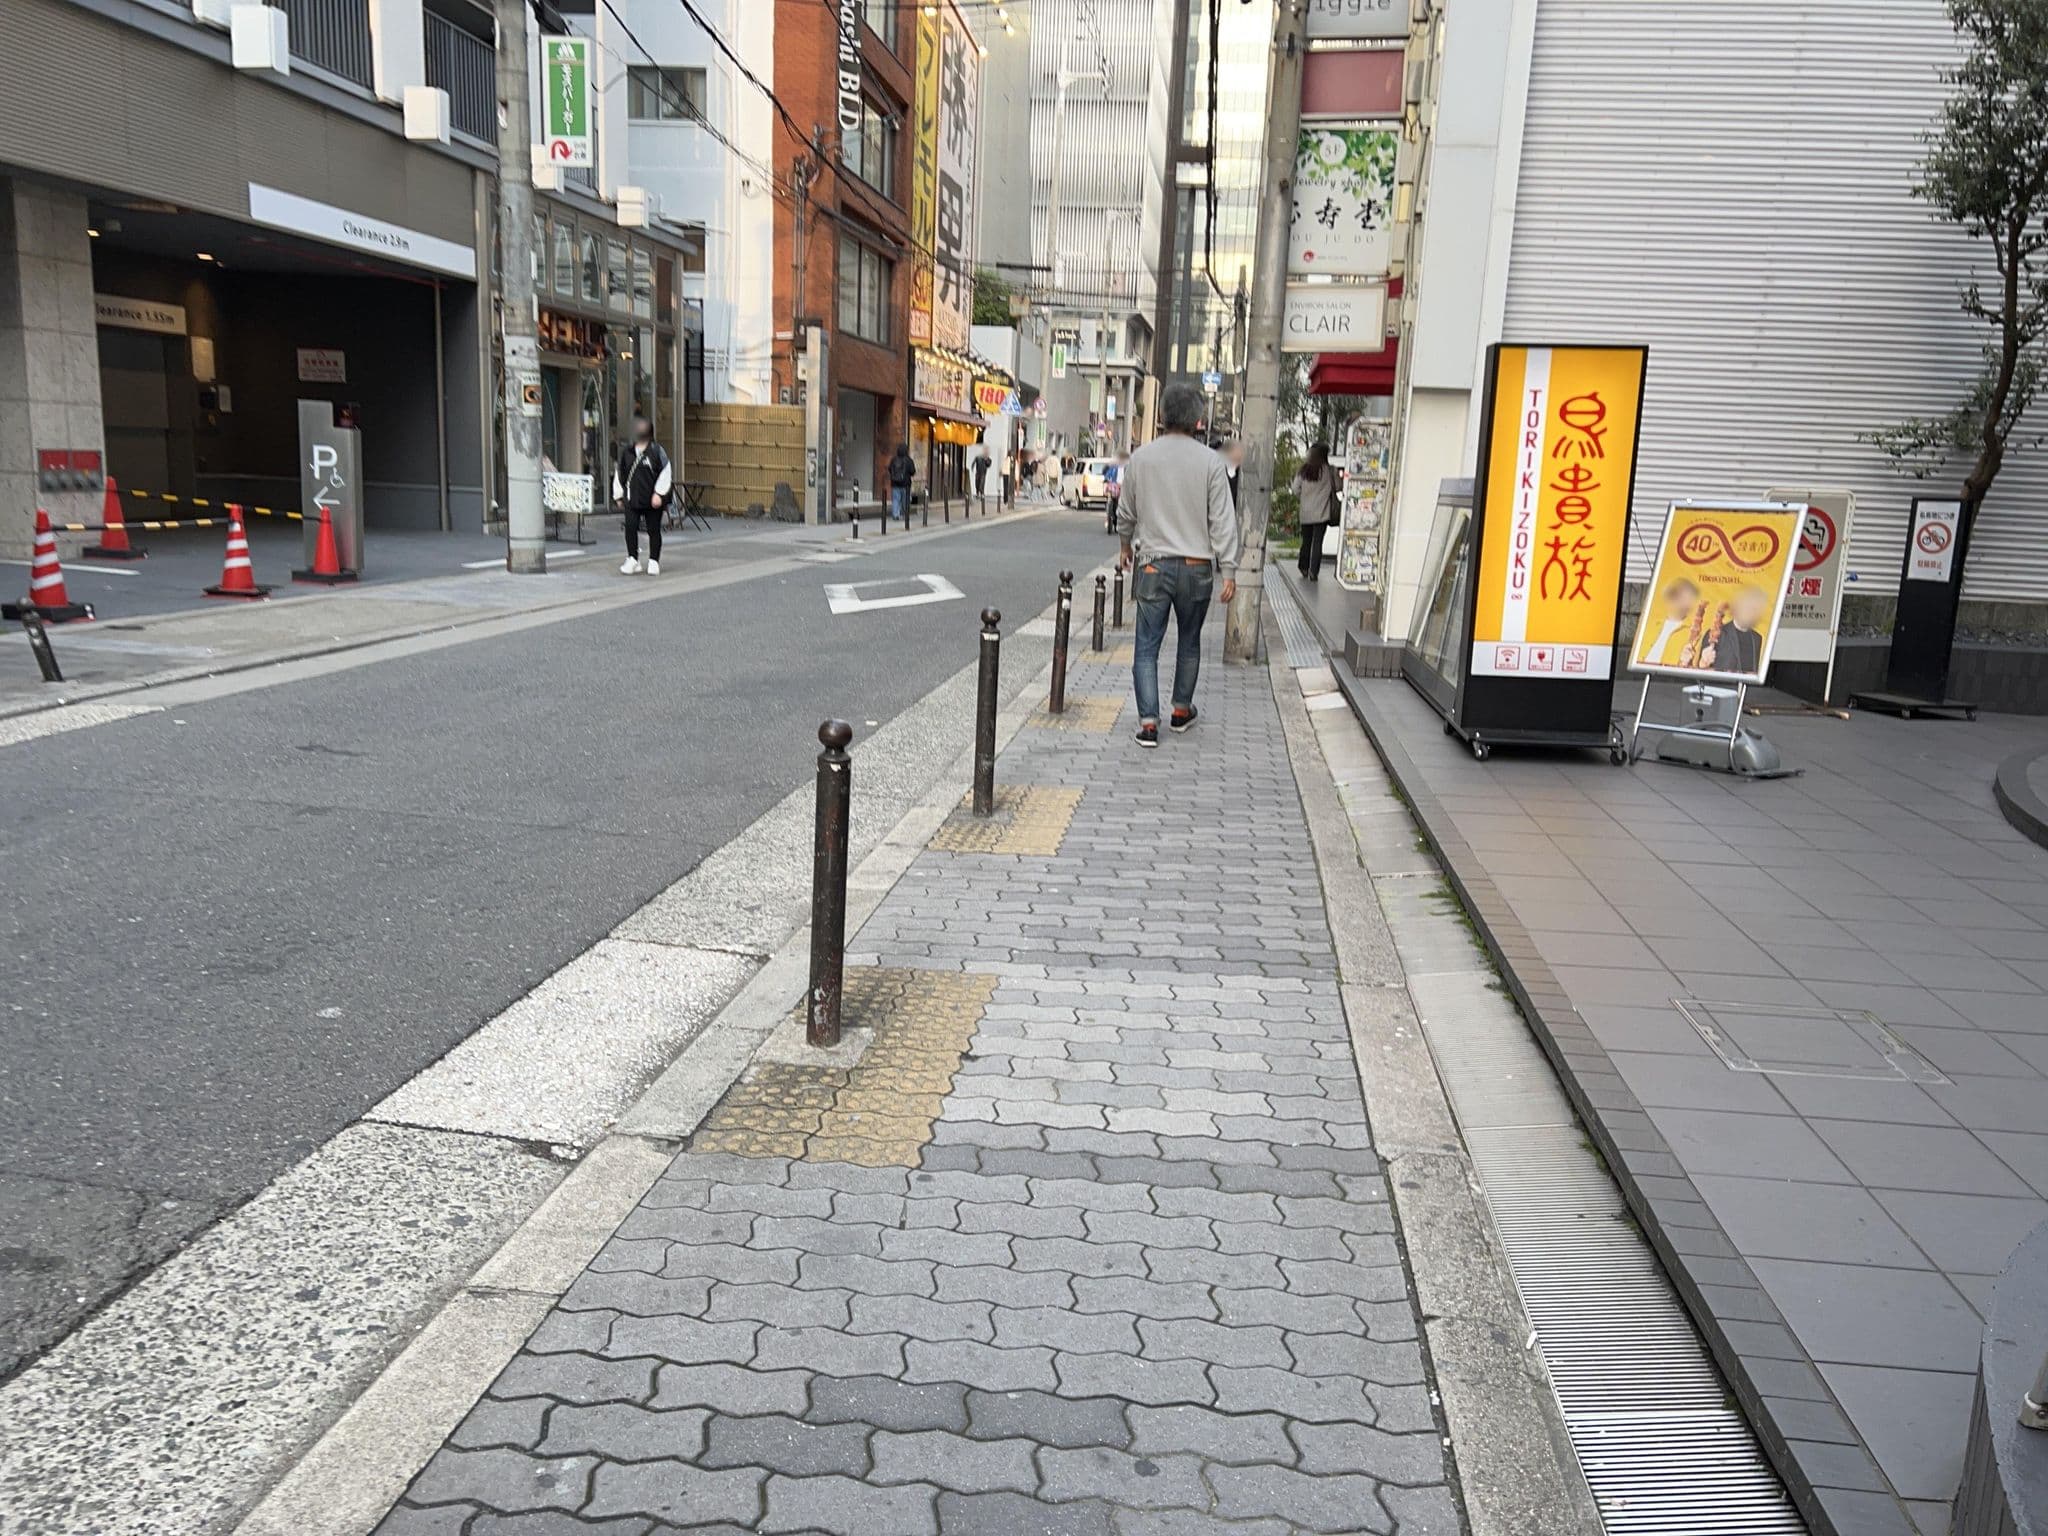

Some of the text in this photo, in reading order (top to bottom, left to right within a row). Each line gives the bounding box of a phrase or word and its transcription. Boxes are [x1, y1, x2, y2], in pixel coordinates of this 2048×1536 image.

[839, 67, 862, 131] BLD
[343, 219, 388, 245] Clearance
[1292, 233, 1312, 243] OU
[96, 303, 142, 320] learance
[1325, 301, 1351, 310] SALON
[1289, 314, 1351, 333] CLAIR
[979, 386, 1005, 405] 180
[312, 444, 338, 480] P
[1512, 389, 1543, 589] TORIKIZOKU
[1541, 391, 1608, 601] 鳥貴族
